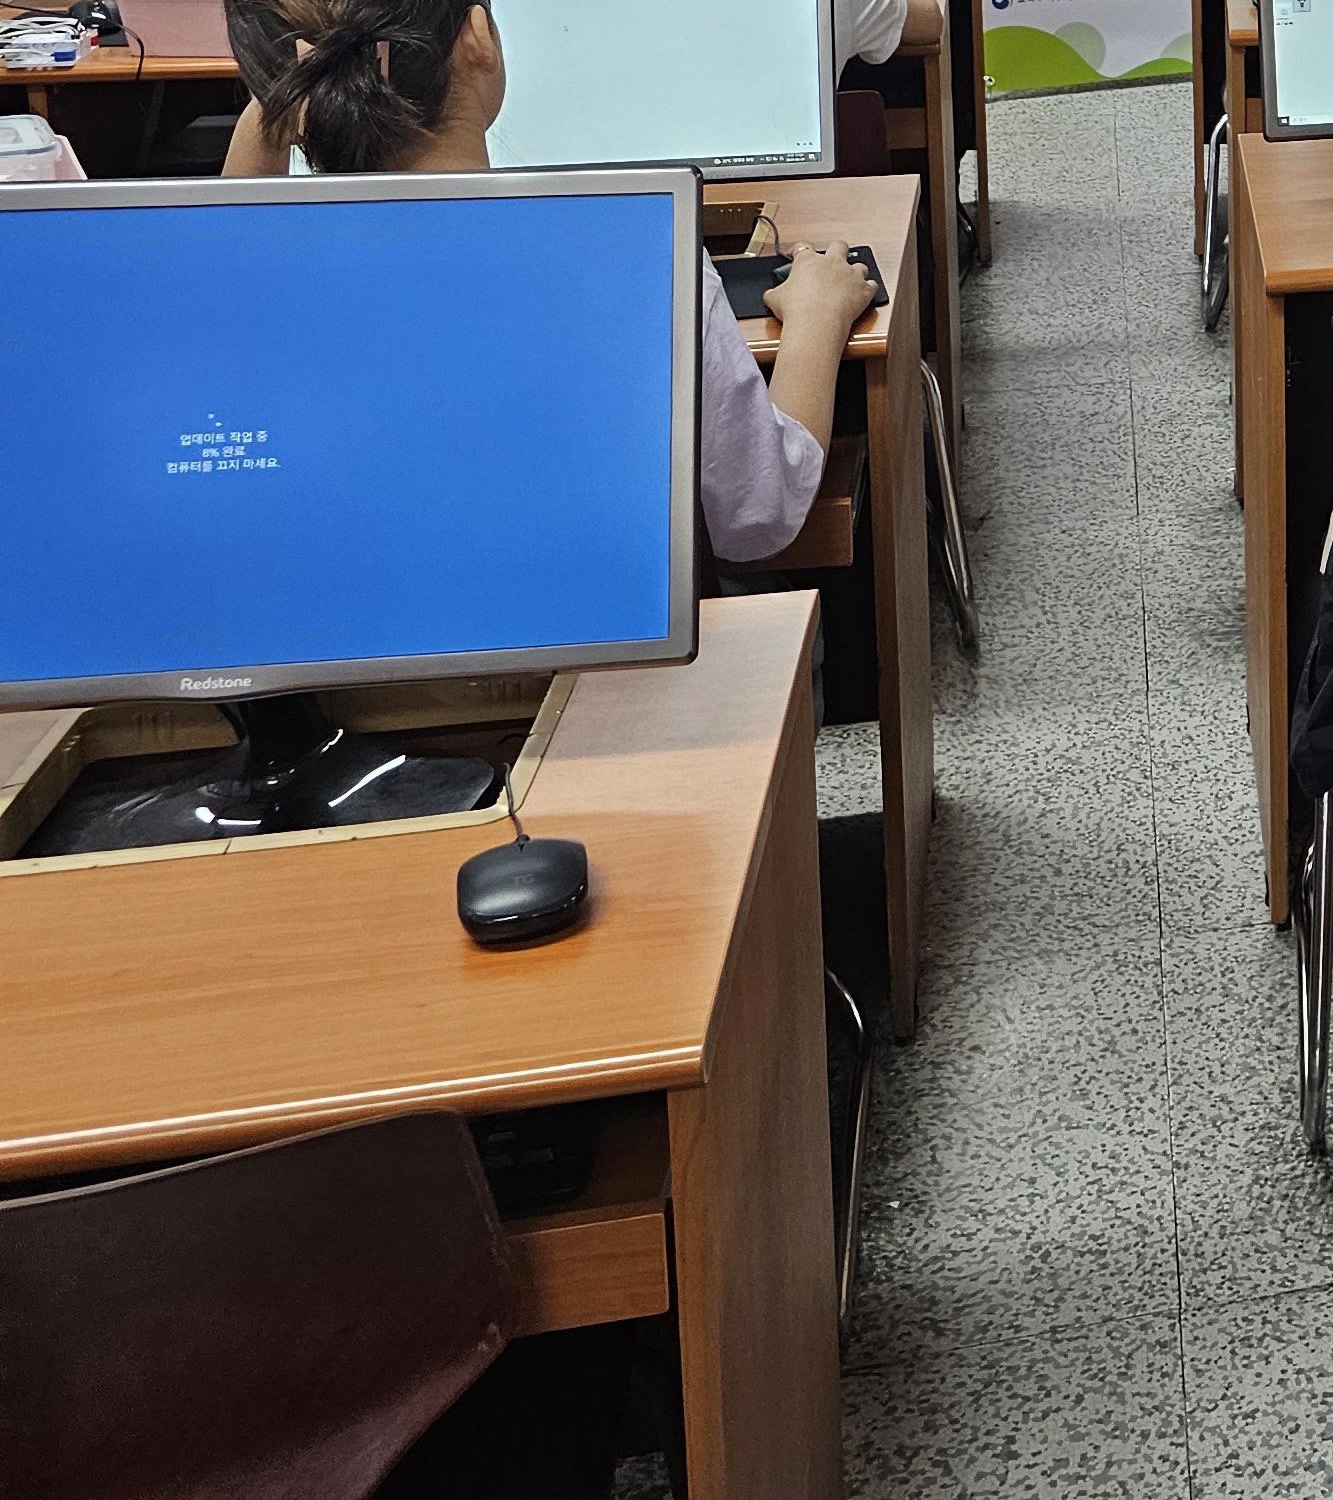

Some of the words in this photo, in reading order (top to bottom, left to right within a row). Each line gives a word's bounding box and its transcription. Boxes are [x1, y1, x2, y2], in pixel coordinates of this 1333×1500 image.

[180, 433, 226, 446] 업데이트
[230, 431, 253, 442] 작업
[256, 430, 268, 442] 중
[202, 448, 220, 457] 8%
[222, 445, 246, 457] 완료
[167, 460, 213, 473] 컴퓨터를
[216, 459, 240, 470] 끄지
[243, 457, 281, 469] 마세요.
[180, 677, 253, 690] Redstone
